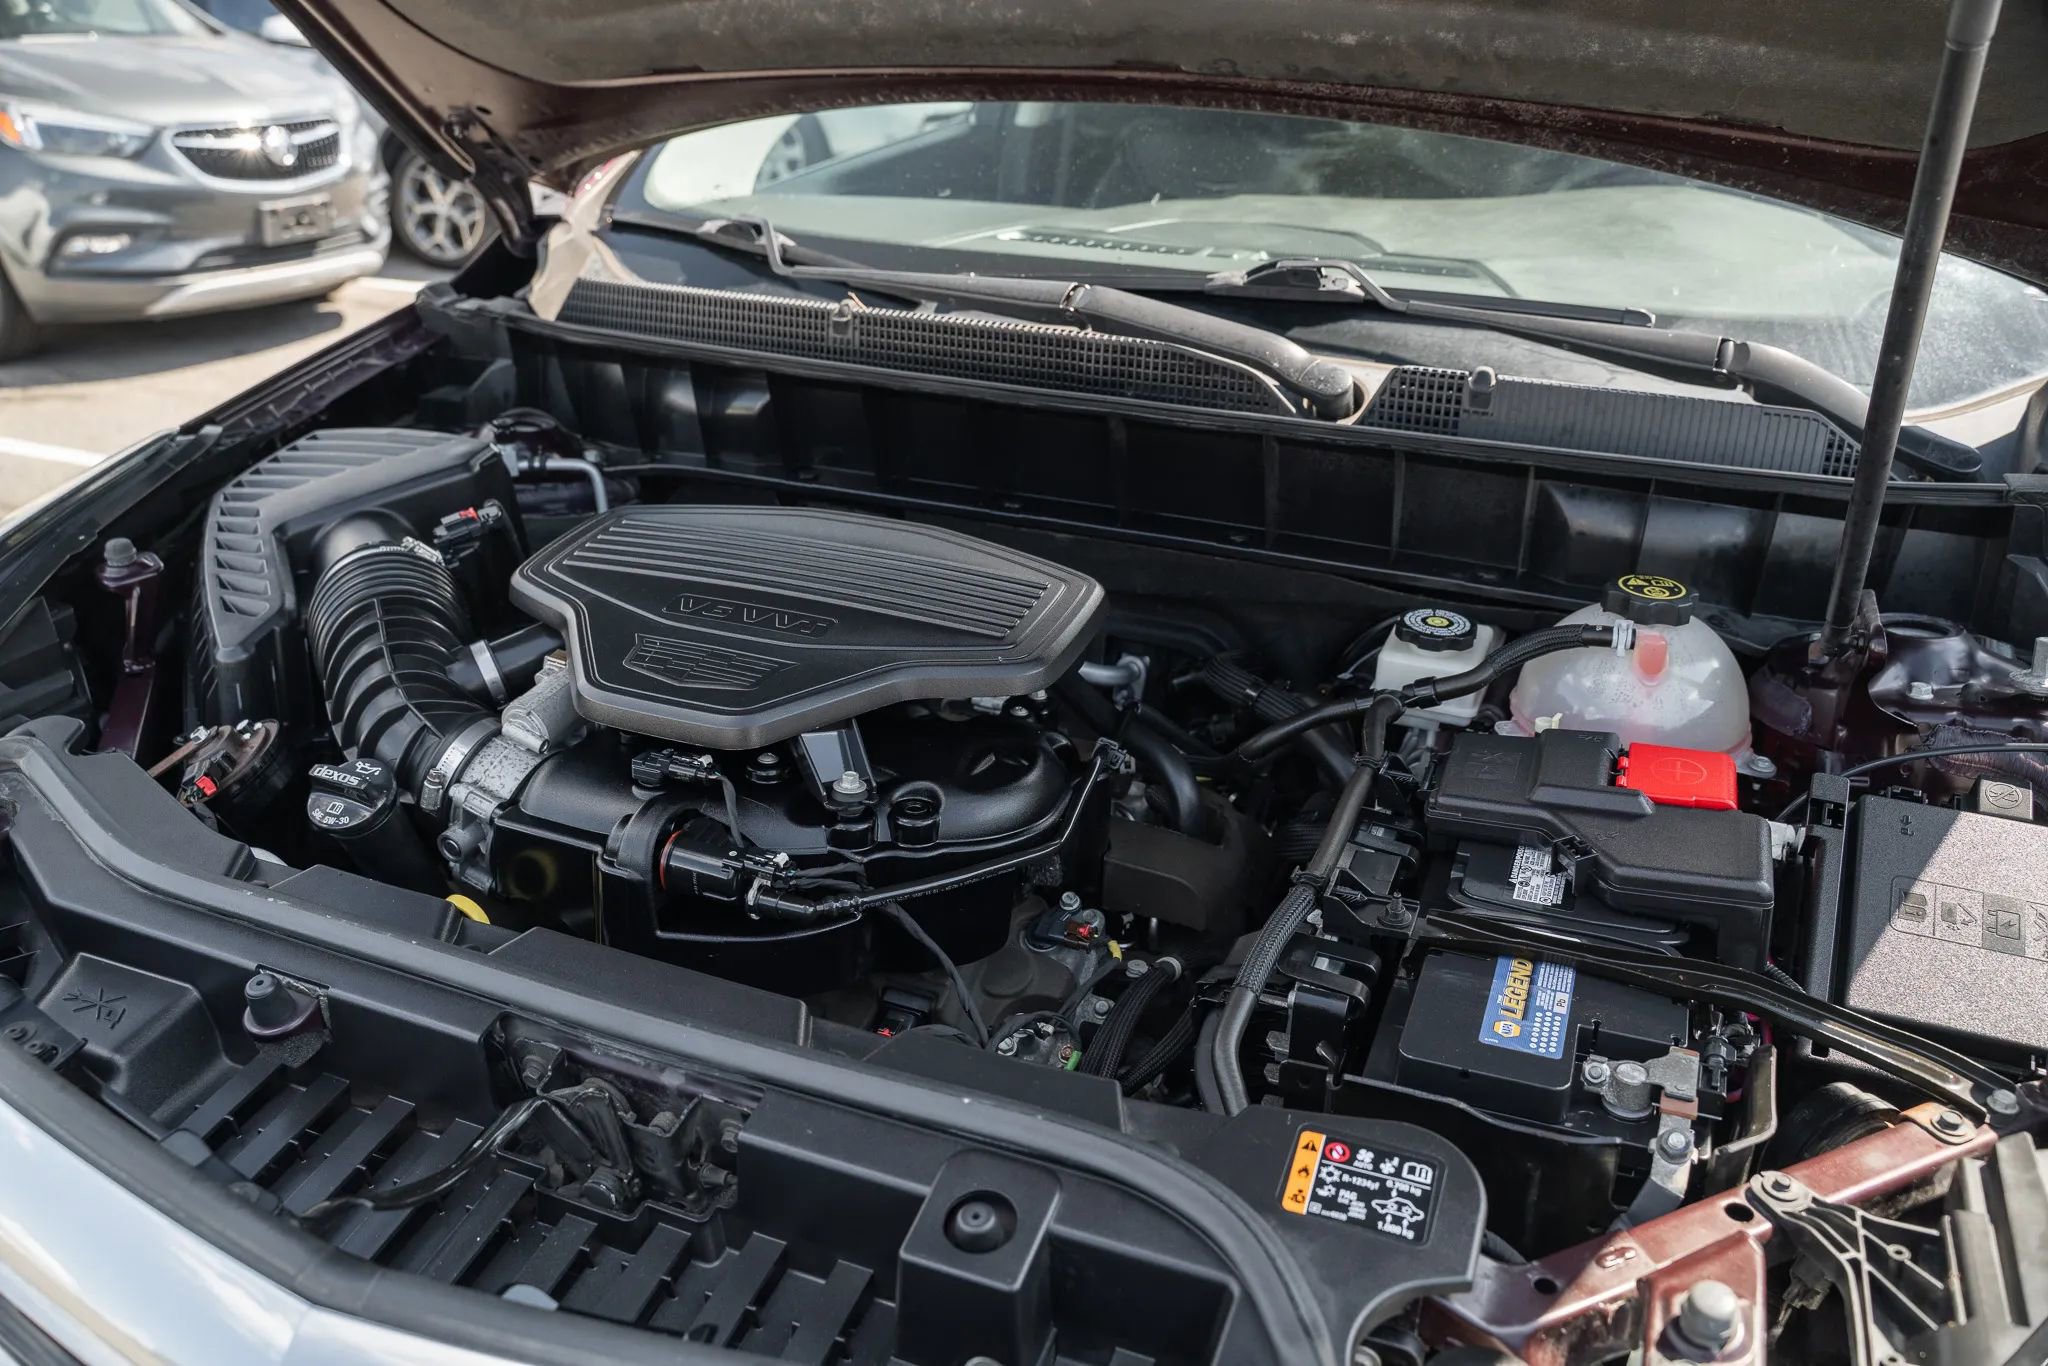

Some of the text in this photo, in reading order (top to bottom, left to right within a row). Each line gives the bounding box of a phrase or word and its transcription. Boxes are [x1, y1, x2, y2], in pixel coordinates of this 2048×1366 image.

[313, 765, 361, 786] dexos
[312, 808, 350, 825] SAE 5W-30
[1500, 958, 1534, 1020] LEGEND
[1555, 998, 1566, 1008] Pb
